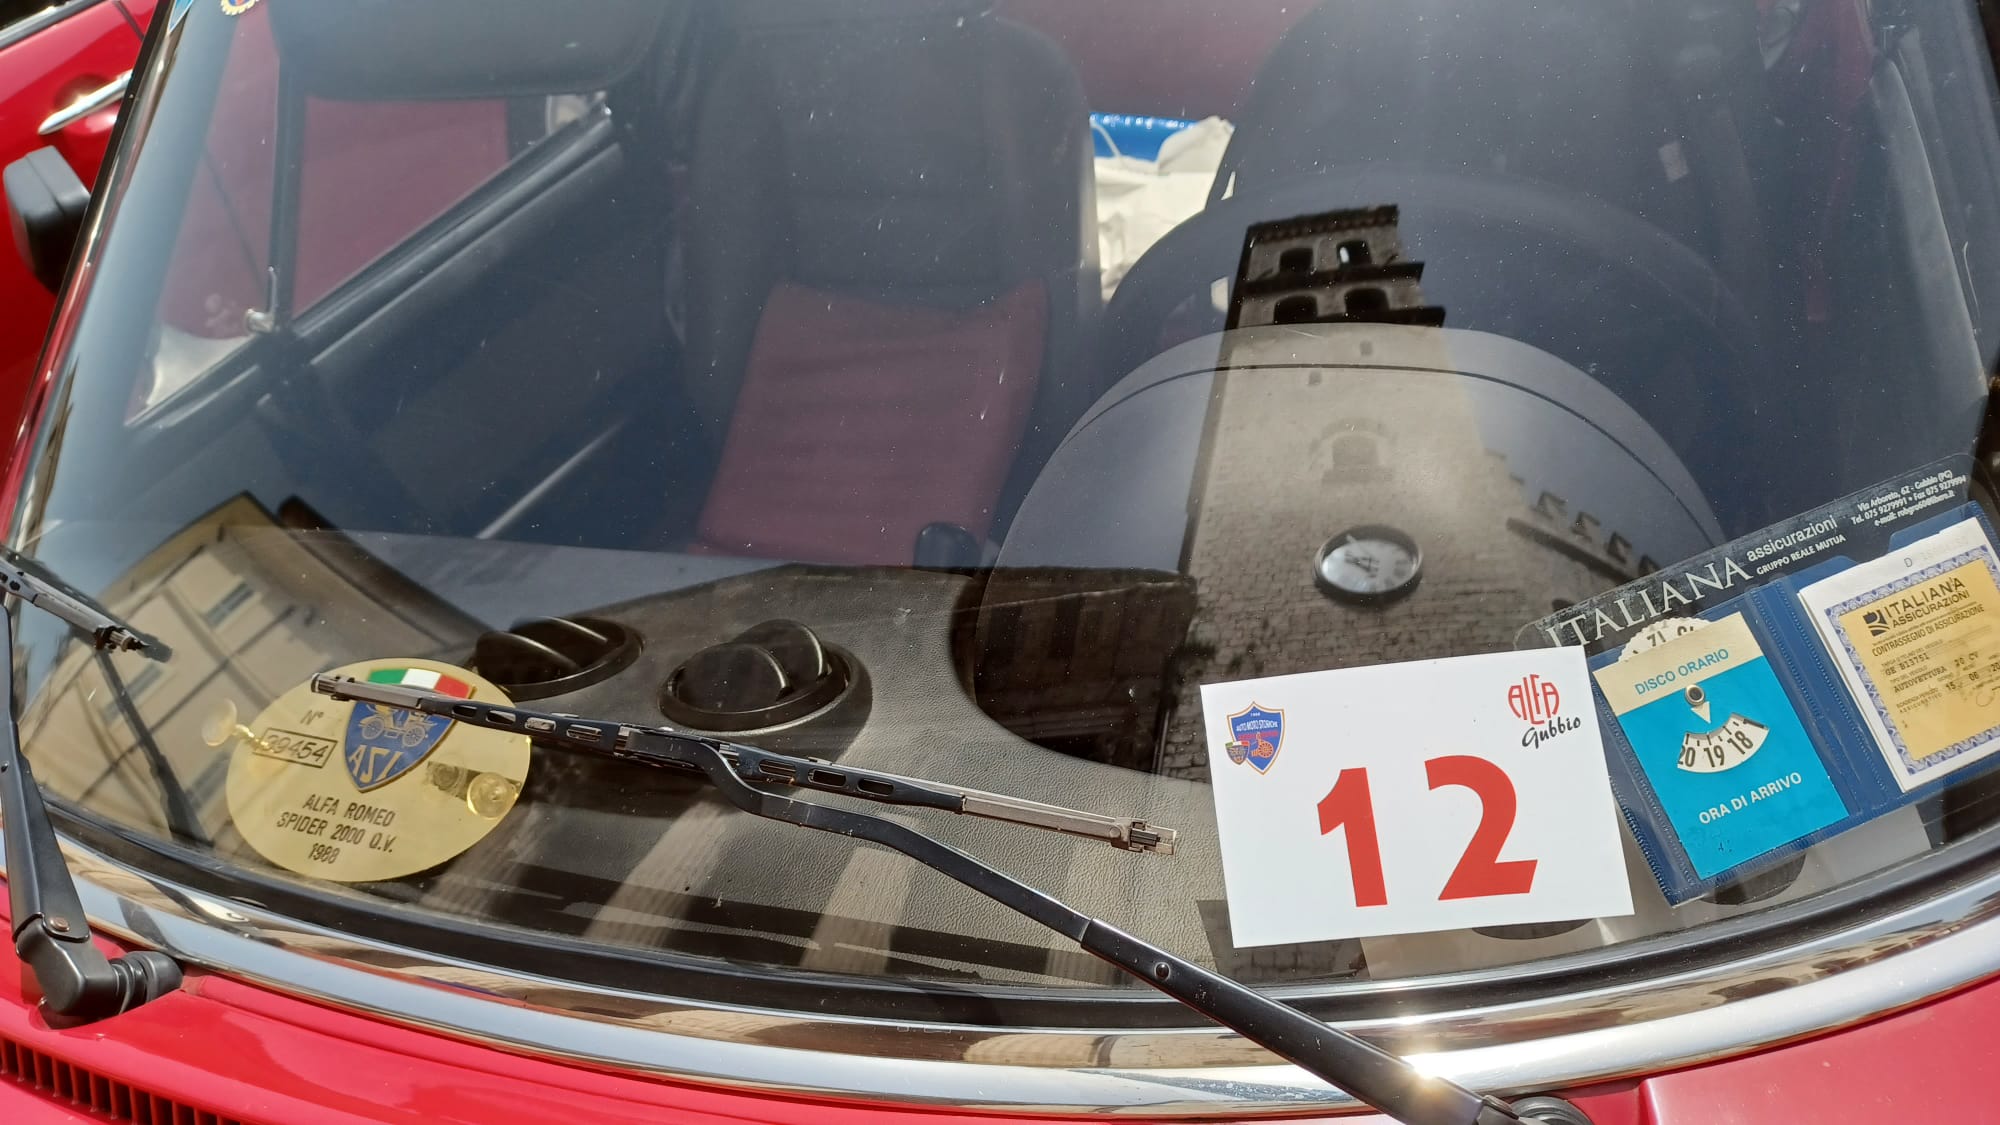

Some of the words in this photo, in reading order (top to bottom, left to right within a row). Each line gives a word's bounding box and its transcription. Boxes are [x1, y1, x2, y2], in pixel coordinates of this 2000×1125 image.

[1857, 502, 1870, 512] Via
[1938, 469, 1953, 482] (PG)
[1864, 507, 1878, 520] 075
[1913, 491, 1926, 501] Fax
[1925, 484, 1939, 496] 075
[1756, 556, 1790, 575] GRUPPO
[1790, 545, 1816, 561] REALE
[1815, 534, 1847, 552] MUTUA
[1545, 556, 1754, 648] ITALIANA
[1746, 514, 1838, 562] assicurazioni
[1883, 576, 1966, 618] ITALIANA
[1892, 589, 1970, 628] ASSICURAZIONI
[1871, 629, 1927, 657] CONTRASSEGNO
[1926, 624, 1936, 635] DI
[1935, 603, 1985, 631] ASSICURAZIONE
[1634, 670, 1676, 695] DISCO
[1677, 648, 1729, 677] ORARIO
[1893, 665, 1947, 693] AUTOVETTURA
[1507, 673, 1560, 725] ALFA
[1521, 716, 1581, 749] Gubbio
[1703, 745, 1725, 768] 19
[1727, 730, 1754, 755] 18
[348, 744, 404, 784] ASI
[302, 793, 341, 816] ALFA
[344, 802, 396, 828] ROMEO
[1698, 803, 1731, 824] ORA
[1730, 795, 1748, 811] DI
[1750, 772, 1802, 804] ARRIVO
[276, 811, 329, 837] SPIDER
[330, 823, 366, 845] 2000
[1317, 754, 1538, 908] 12
[308, 842, 341, 864] 1988
